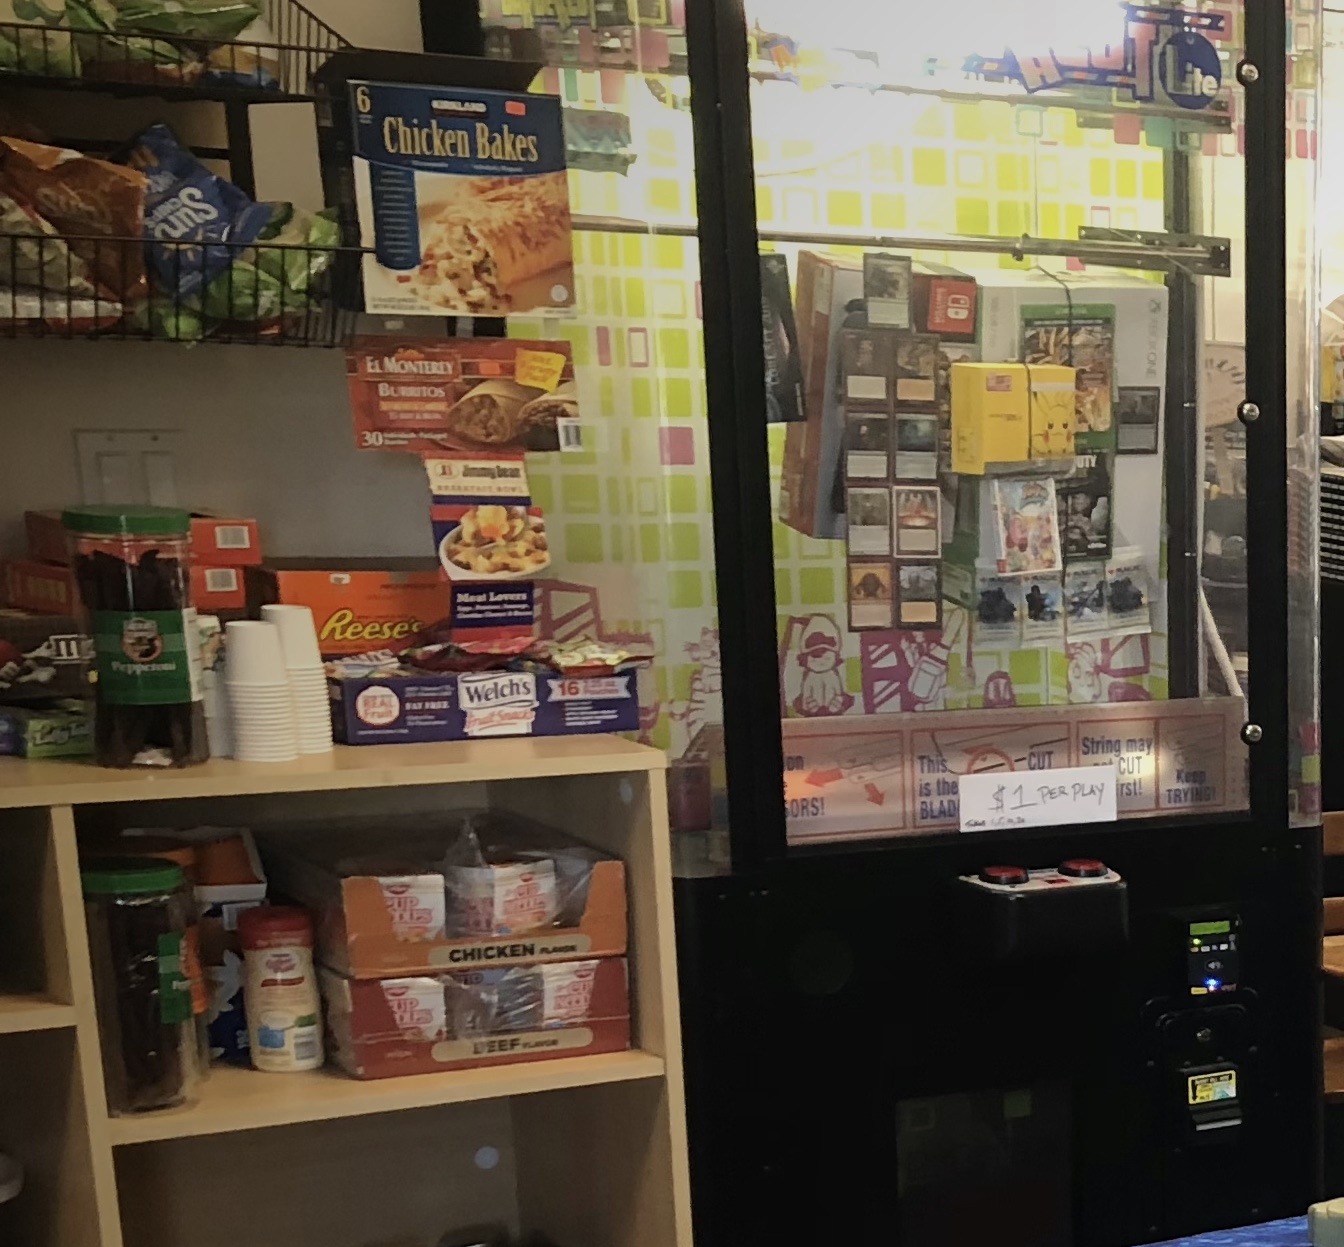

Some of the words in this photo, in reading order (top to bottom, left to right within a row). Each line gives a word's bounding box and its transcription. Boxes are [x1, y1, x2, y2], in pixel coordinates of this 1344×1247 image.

[355, 86, 371, 113] 6
[383, 116, 471, 158] Chicken
[475, 122, 540, 163] Bakes
[365, 356, 383, 374] EL
[383, 356, 455, 375] MONTEREY
[378, 382, 446, 398] BURRITOS
[361, 430, 383, 447] 30
[1074, 454, 1098, 469] UTY
[456, 592, 488, 603] Meat
[489, 591, 527, 602] Lovers
[319, 608, 424, 641] Reese's
[465, 676, 532, 704] Welch's
[558, 680, 580, 696] 16
[1081, 735, 1122, 757] String
[1126, 736, 1154, 755] may
[917, 754, 949, 774] This
[1027, 751, 1054, 771] CUT
[1118, 756, 1143, 775] CUT
[919, 781, 935, 798] is
[936, 778, 959, 797] the
[1037, 783, 1069, 800] PER
[1071, 781, 1106, 806] PLAY
[1116, 779, 1143, 797] irst!
[919, 800, 960, 821] BLAD
[449, 944, 536, 963] CHICKEN
